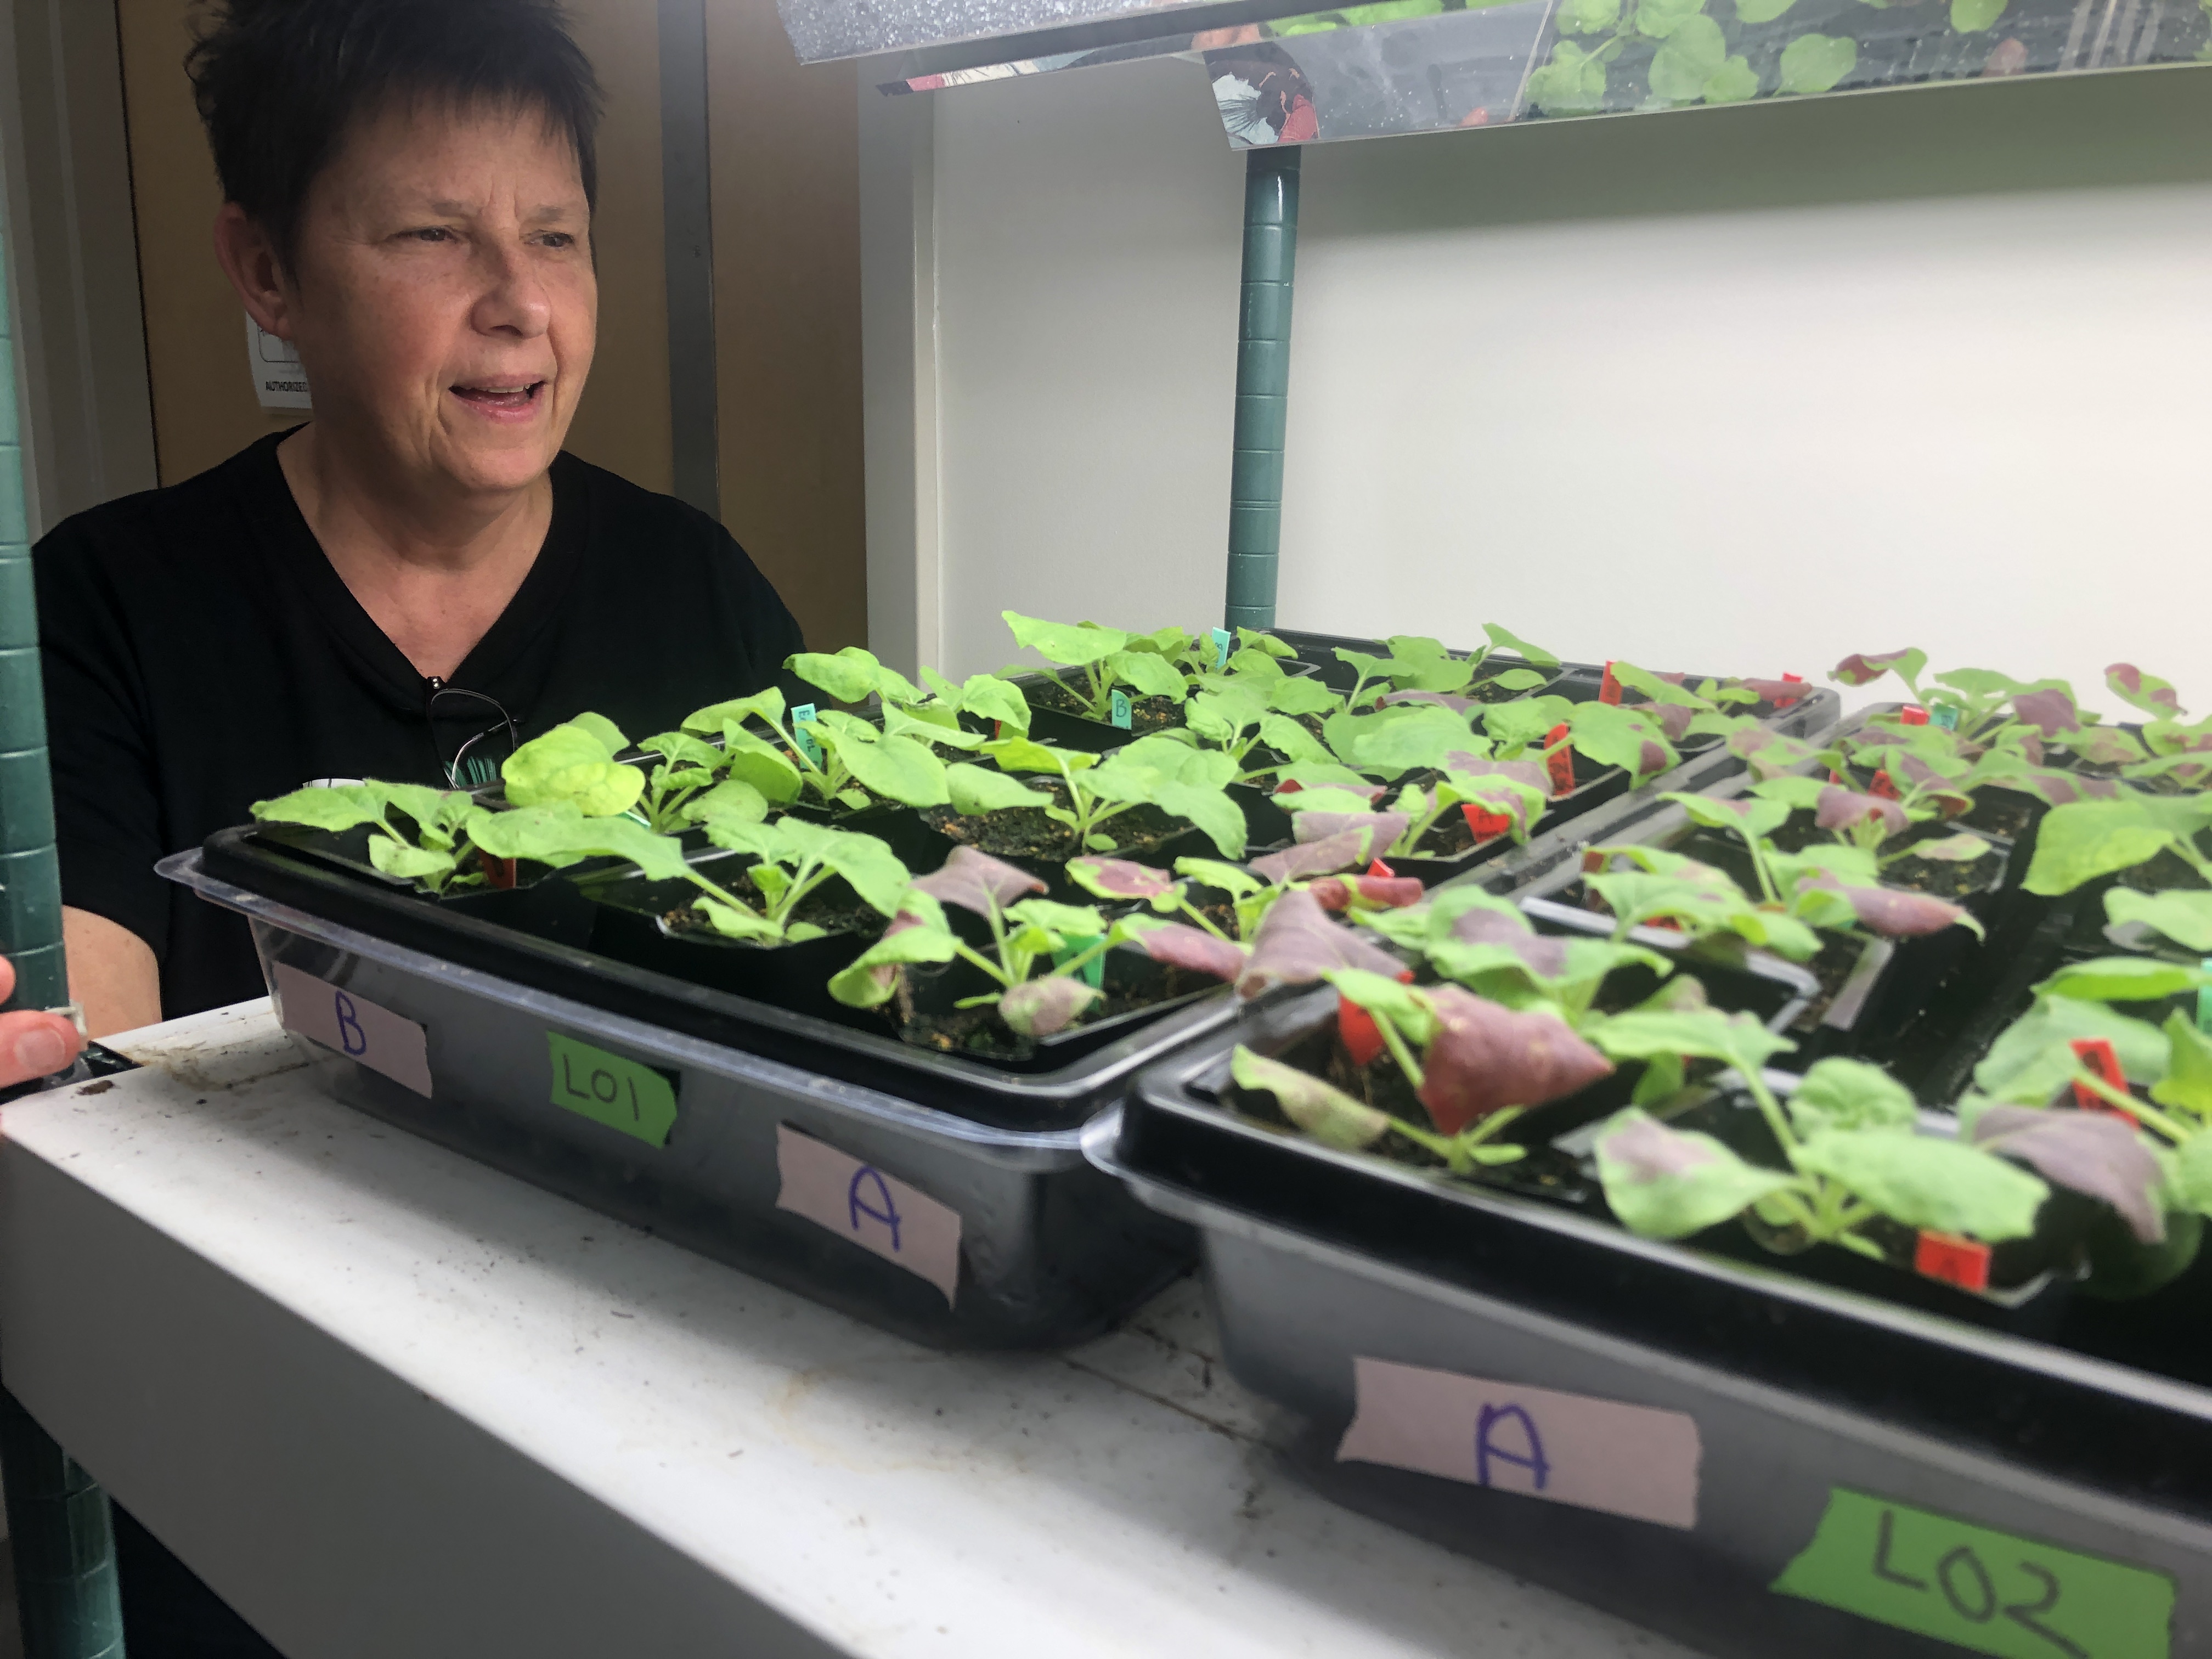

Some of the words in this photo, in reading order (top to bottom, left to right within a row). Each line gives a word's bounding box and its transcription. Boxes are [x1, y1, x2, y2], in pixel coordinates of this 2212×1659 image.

[1116, 698, 1127, 718] B
[335, 990, 366, 1056] B
[848, 1164, 901, 1252] A
[1475, 1402, 1551, 1491] A
[1872, 1509, 2091, 1659] L02
